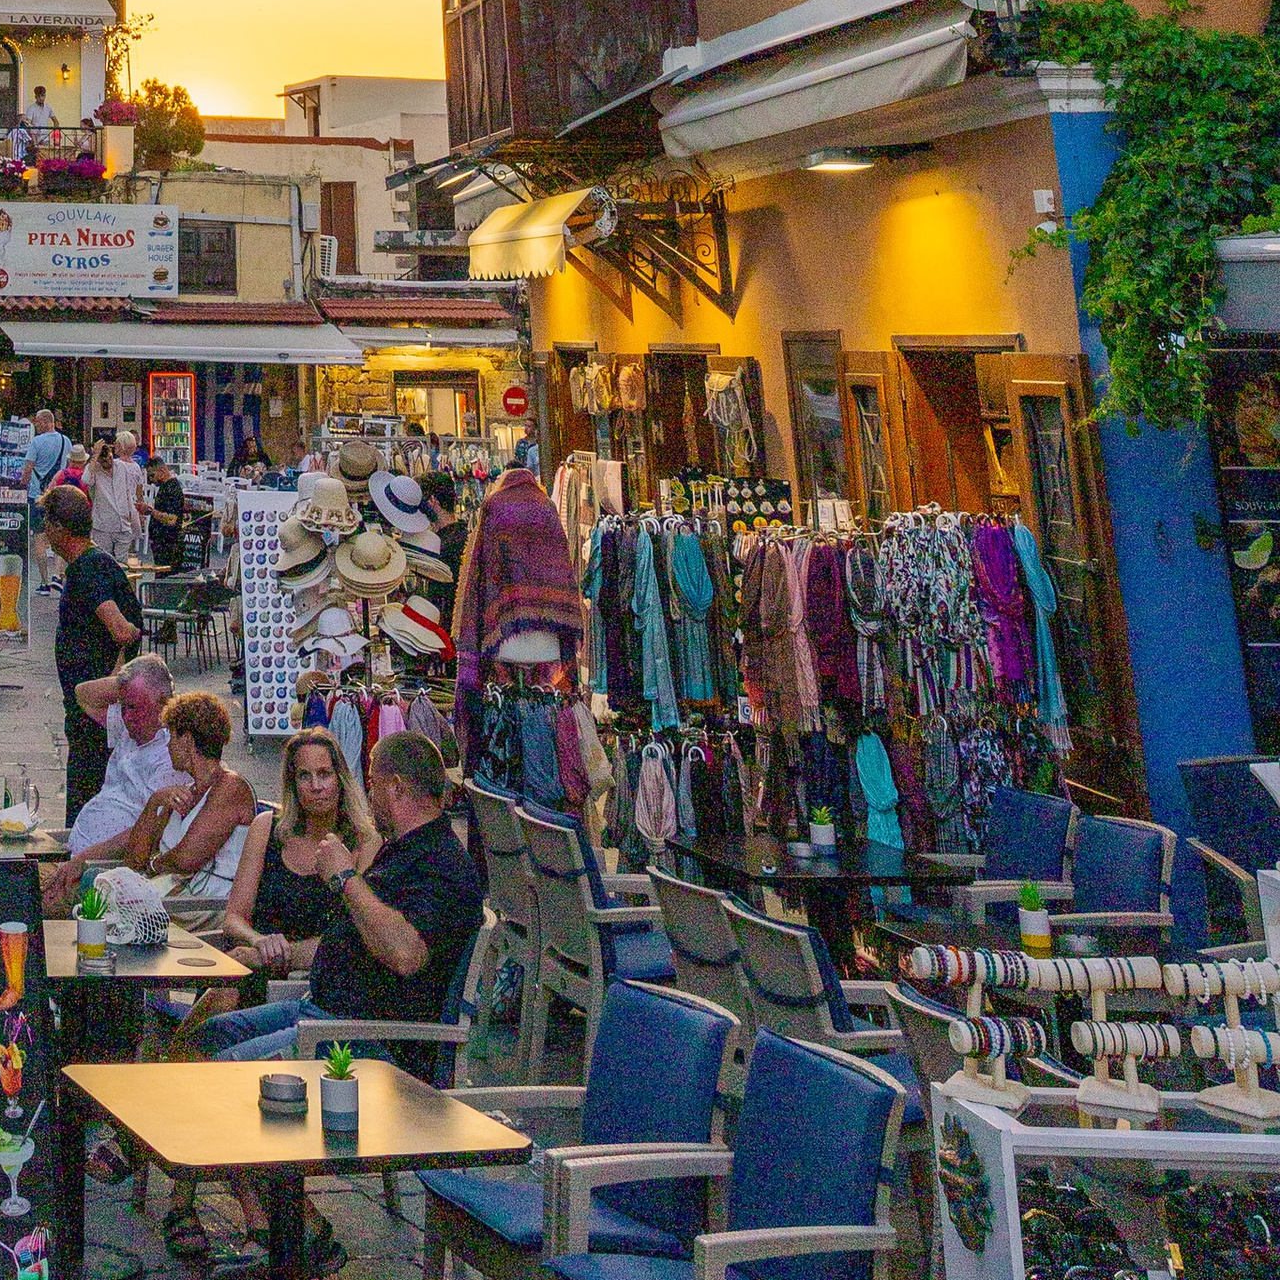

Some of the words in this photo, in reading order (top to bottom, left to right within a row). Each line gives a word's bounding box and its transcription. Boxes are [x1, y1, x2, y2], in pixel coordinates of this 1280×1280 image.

[10, 15, 29, 24] LA
[32, 15, 104, 26] VERANDA
[47, 208, 116, 227] SOUVLAKI
[28, 232, 72, 246] PITA
[76, 228, 135, 248] NIKOS
[147, 244, 174, 252] BURGER
[51, 253, 111, 269] GYROS
[147, 253, 173, 262] HOUSE
